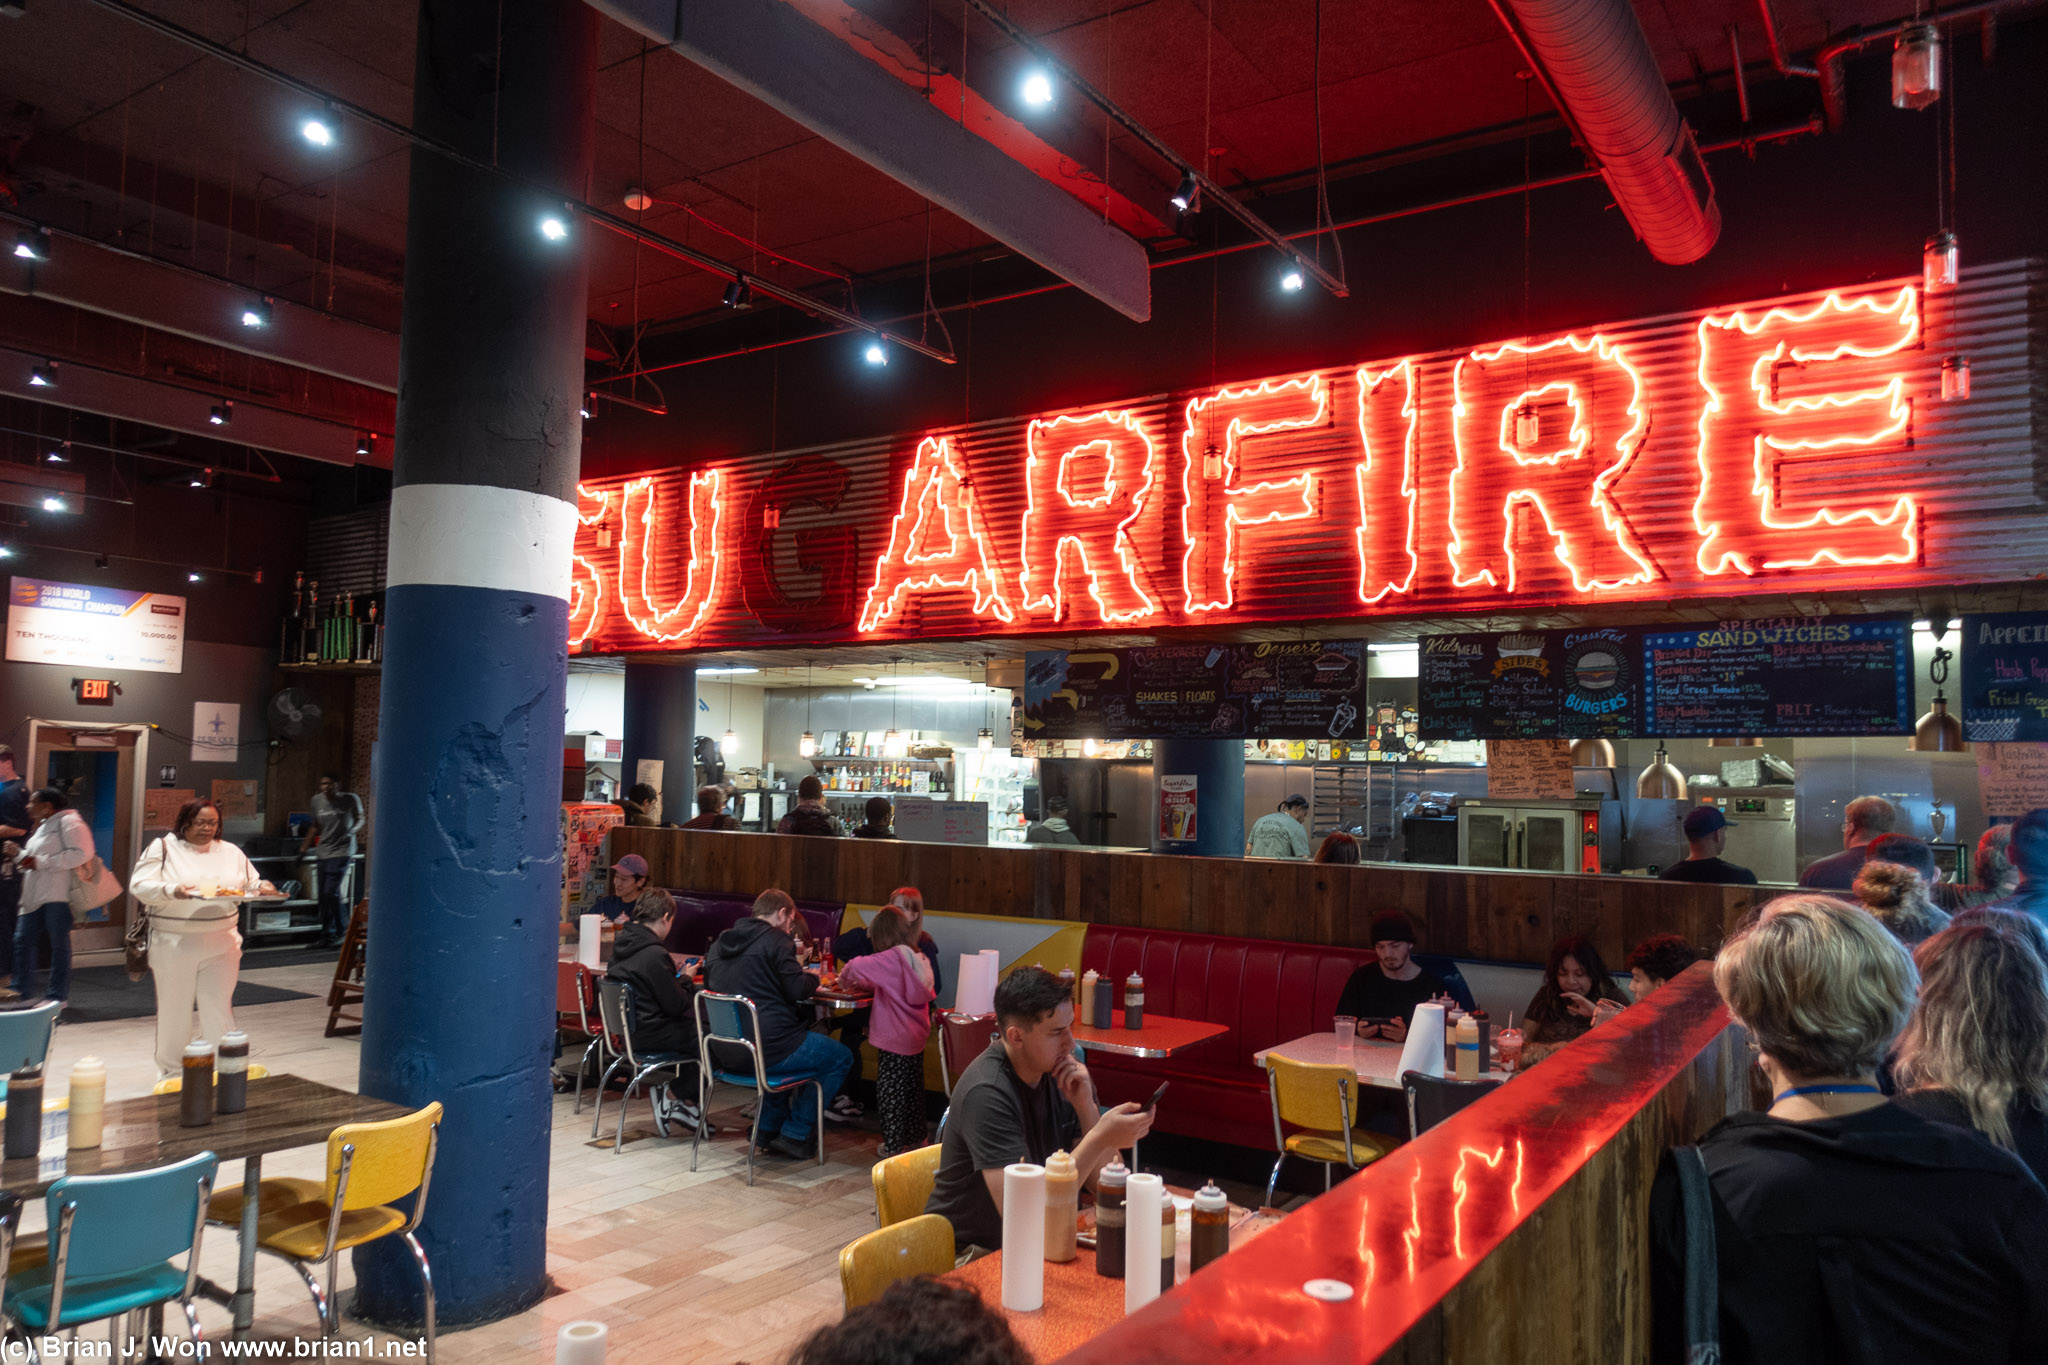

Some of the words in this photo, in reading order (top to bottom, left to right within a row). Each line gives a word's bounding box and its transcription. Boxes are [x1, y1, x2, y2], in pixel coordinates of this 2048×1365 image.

[40, 585, 62, 597] 2018
[62, 587, 91, 600] WORLD
[40, 596, 84, 610] SANDWICH
[85, 600, 127, 615] CHAMPION
[1719, 616, 1824, 632] SPECIALTY
[16, 630, 35, 639] TEN
[1696, 624, 1850, 648] SANDWICHES
[1145, 646, 1207, 659] BEVERAGES
[1254, 641, 1321, 658] Dessert
[1425, 637, 1460, 654] Kids
[1457, 644, 1484, 656] MEAL
[1501, 657, 1543, 669] SIDES
[1995, 657, 2024, 678] Hush
[1655, 665, 1702, 676] Carolina
[83, 680, 110, 699] EXIT
[1521, 683, 1548, 695] Salad
[1656, 684, 1680, 695] Fried
[1683, 684, 1709, 695] Green
[1136, 691, 1178, 702] SHAKES
[1185, 690, 1216, 703] FLOATS
[1285, 692, 1321, 701] SHAKES
[1565, 692, 1628, 715] BURGERS
[1989, 689, 2020, 706] Fried
[1108, 704, 1127, 714] PIE
[1422, 715, 1445, 729] Chef
[1447, 715, 1473, 729] Salad
